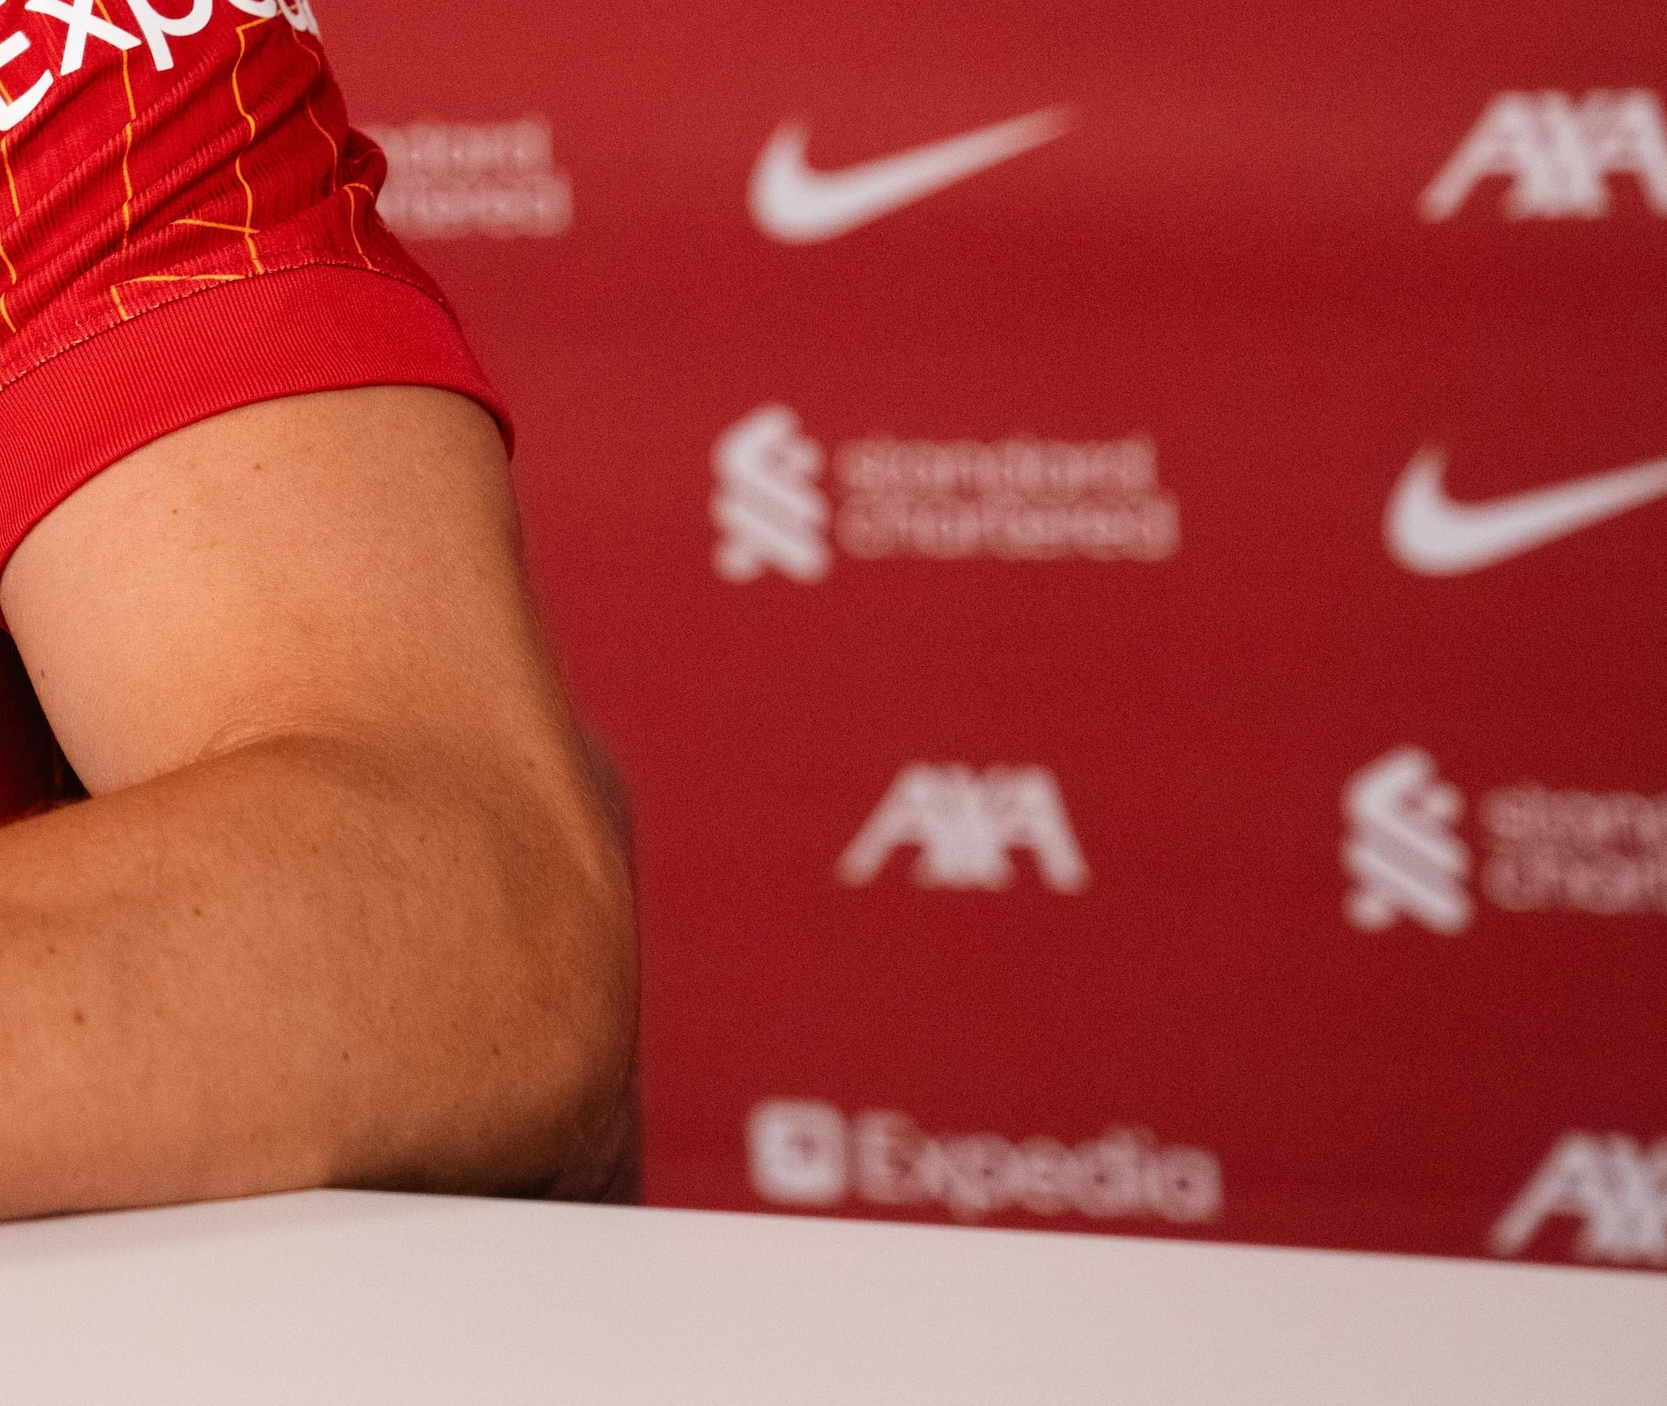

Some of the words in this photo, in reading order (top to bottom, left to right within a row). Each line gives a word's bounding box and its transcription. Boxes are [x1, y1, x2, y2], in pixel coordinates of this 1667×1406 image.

[835, 434, 1156, 493] standard
[838, 491, 1180, 559] chartered
[835, 762, 1091, 895] AXA
[855, 1109, 1223, 1225] Expedia
[1487, 1129, 1667, 1260] AX
